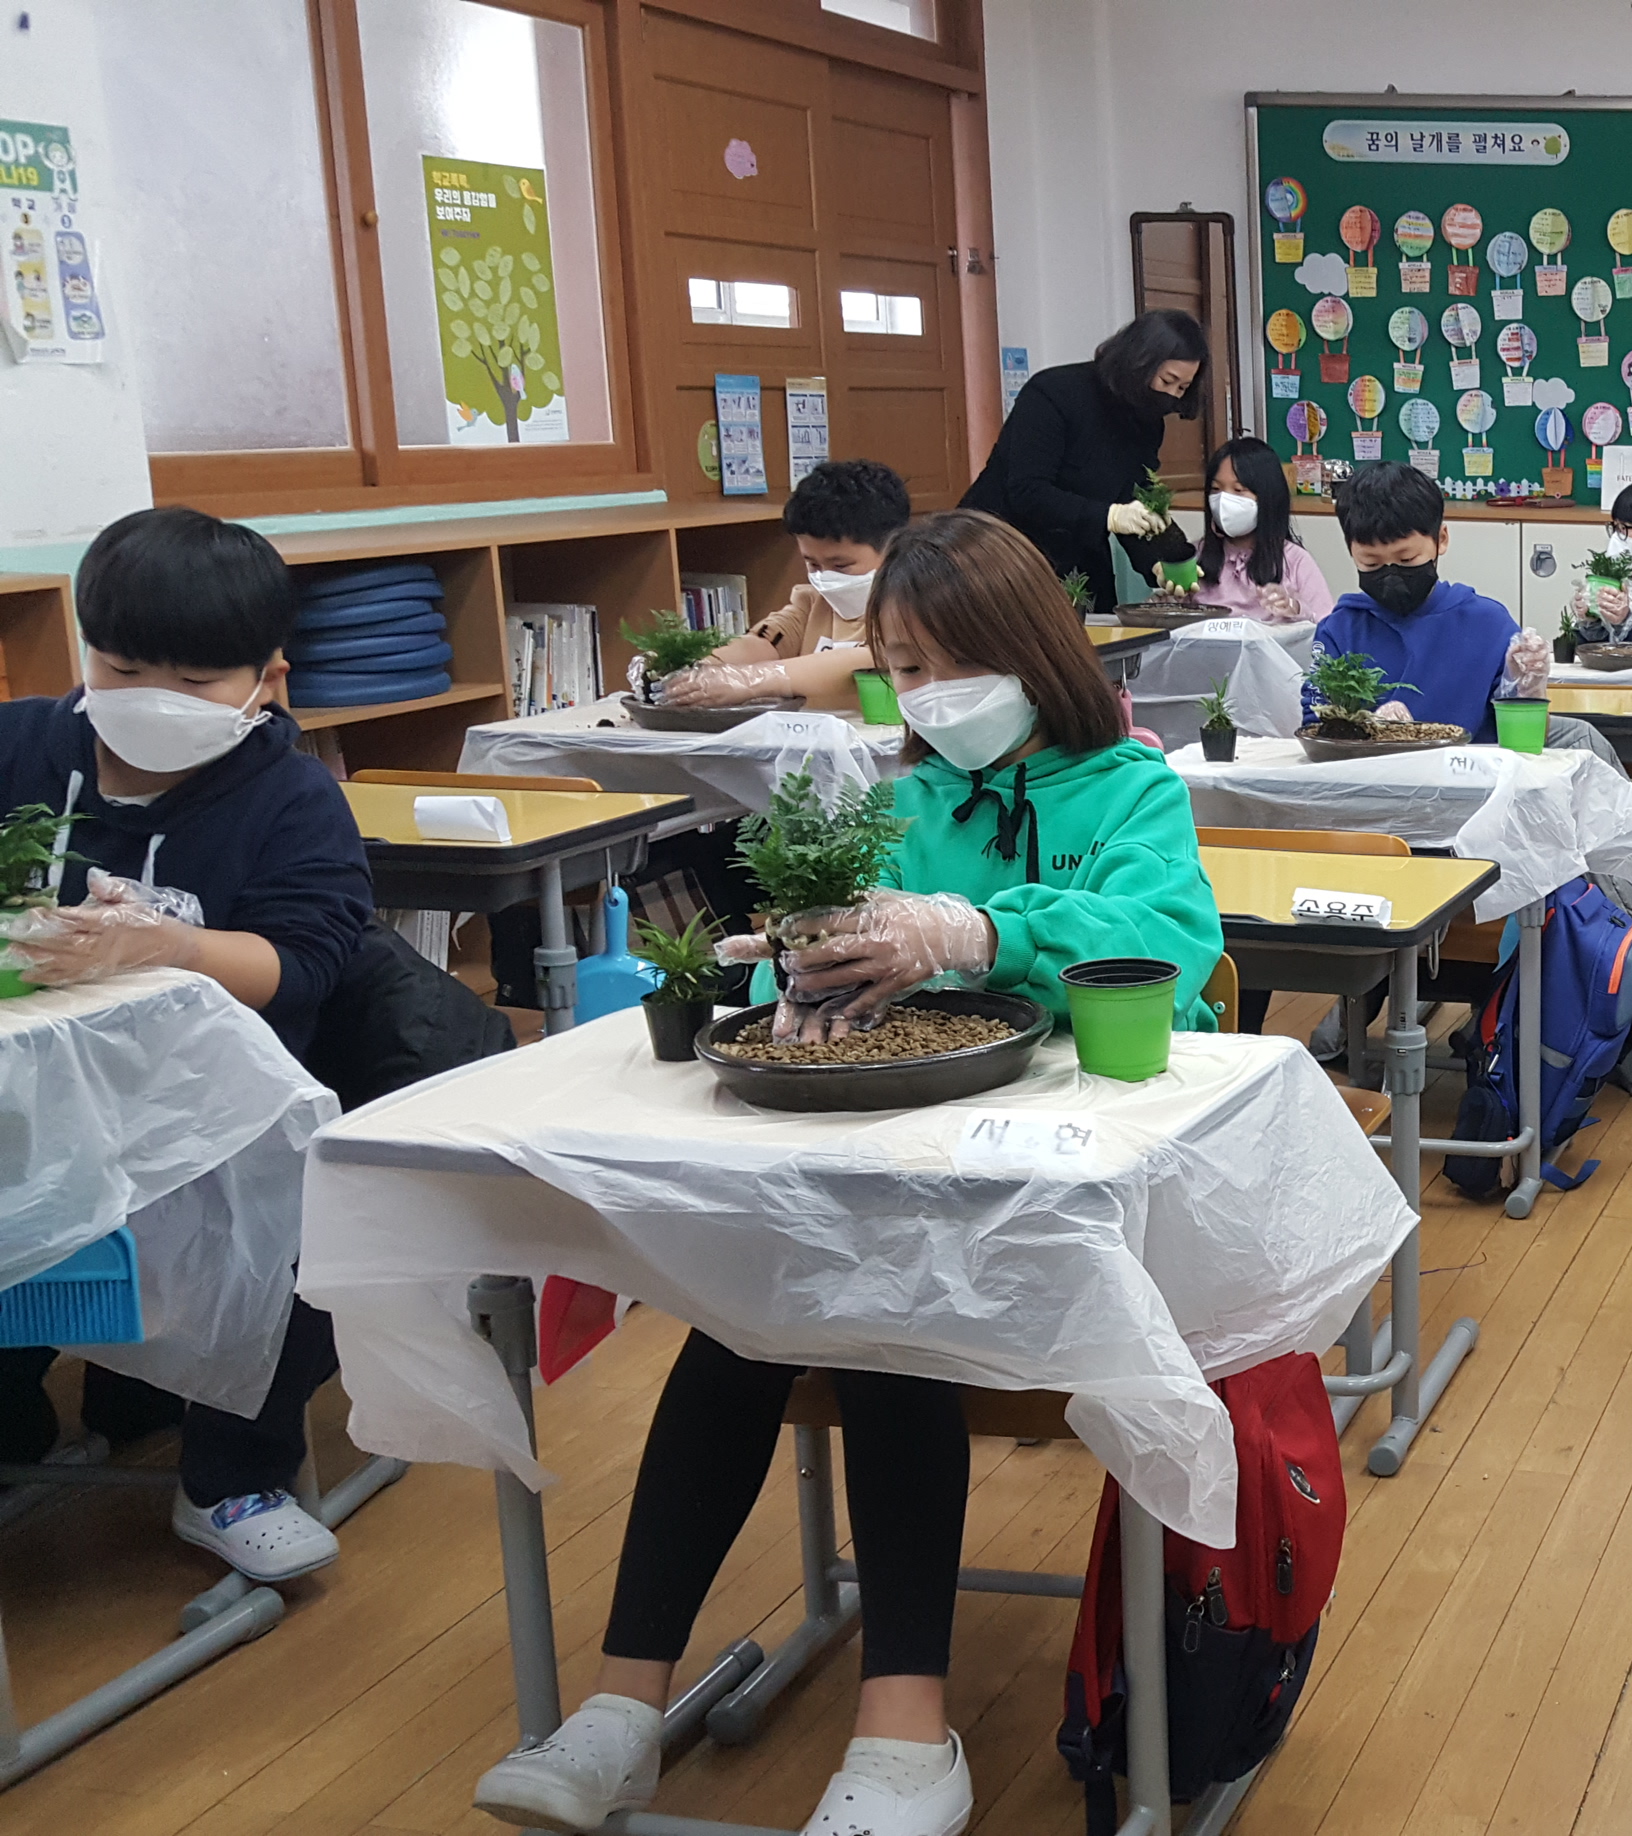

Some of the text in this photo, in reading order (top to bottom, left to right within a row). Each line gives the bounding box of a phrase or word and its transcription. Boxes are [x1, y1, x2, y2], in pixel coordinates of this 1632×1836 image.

[1365, 130, 1526, 155] 꿈의 날개를 펼쳐요
